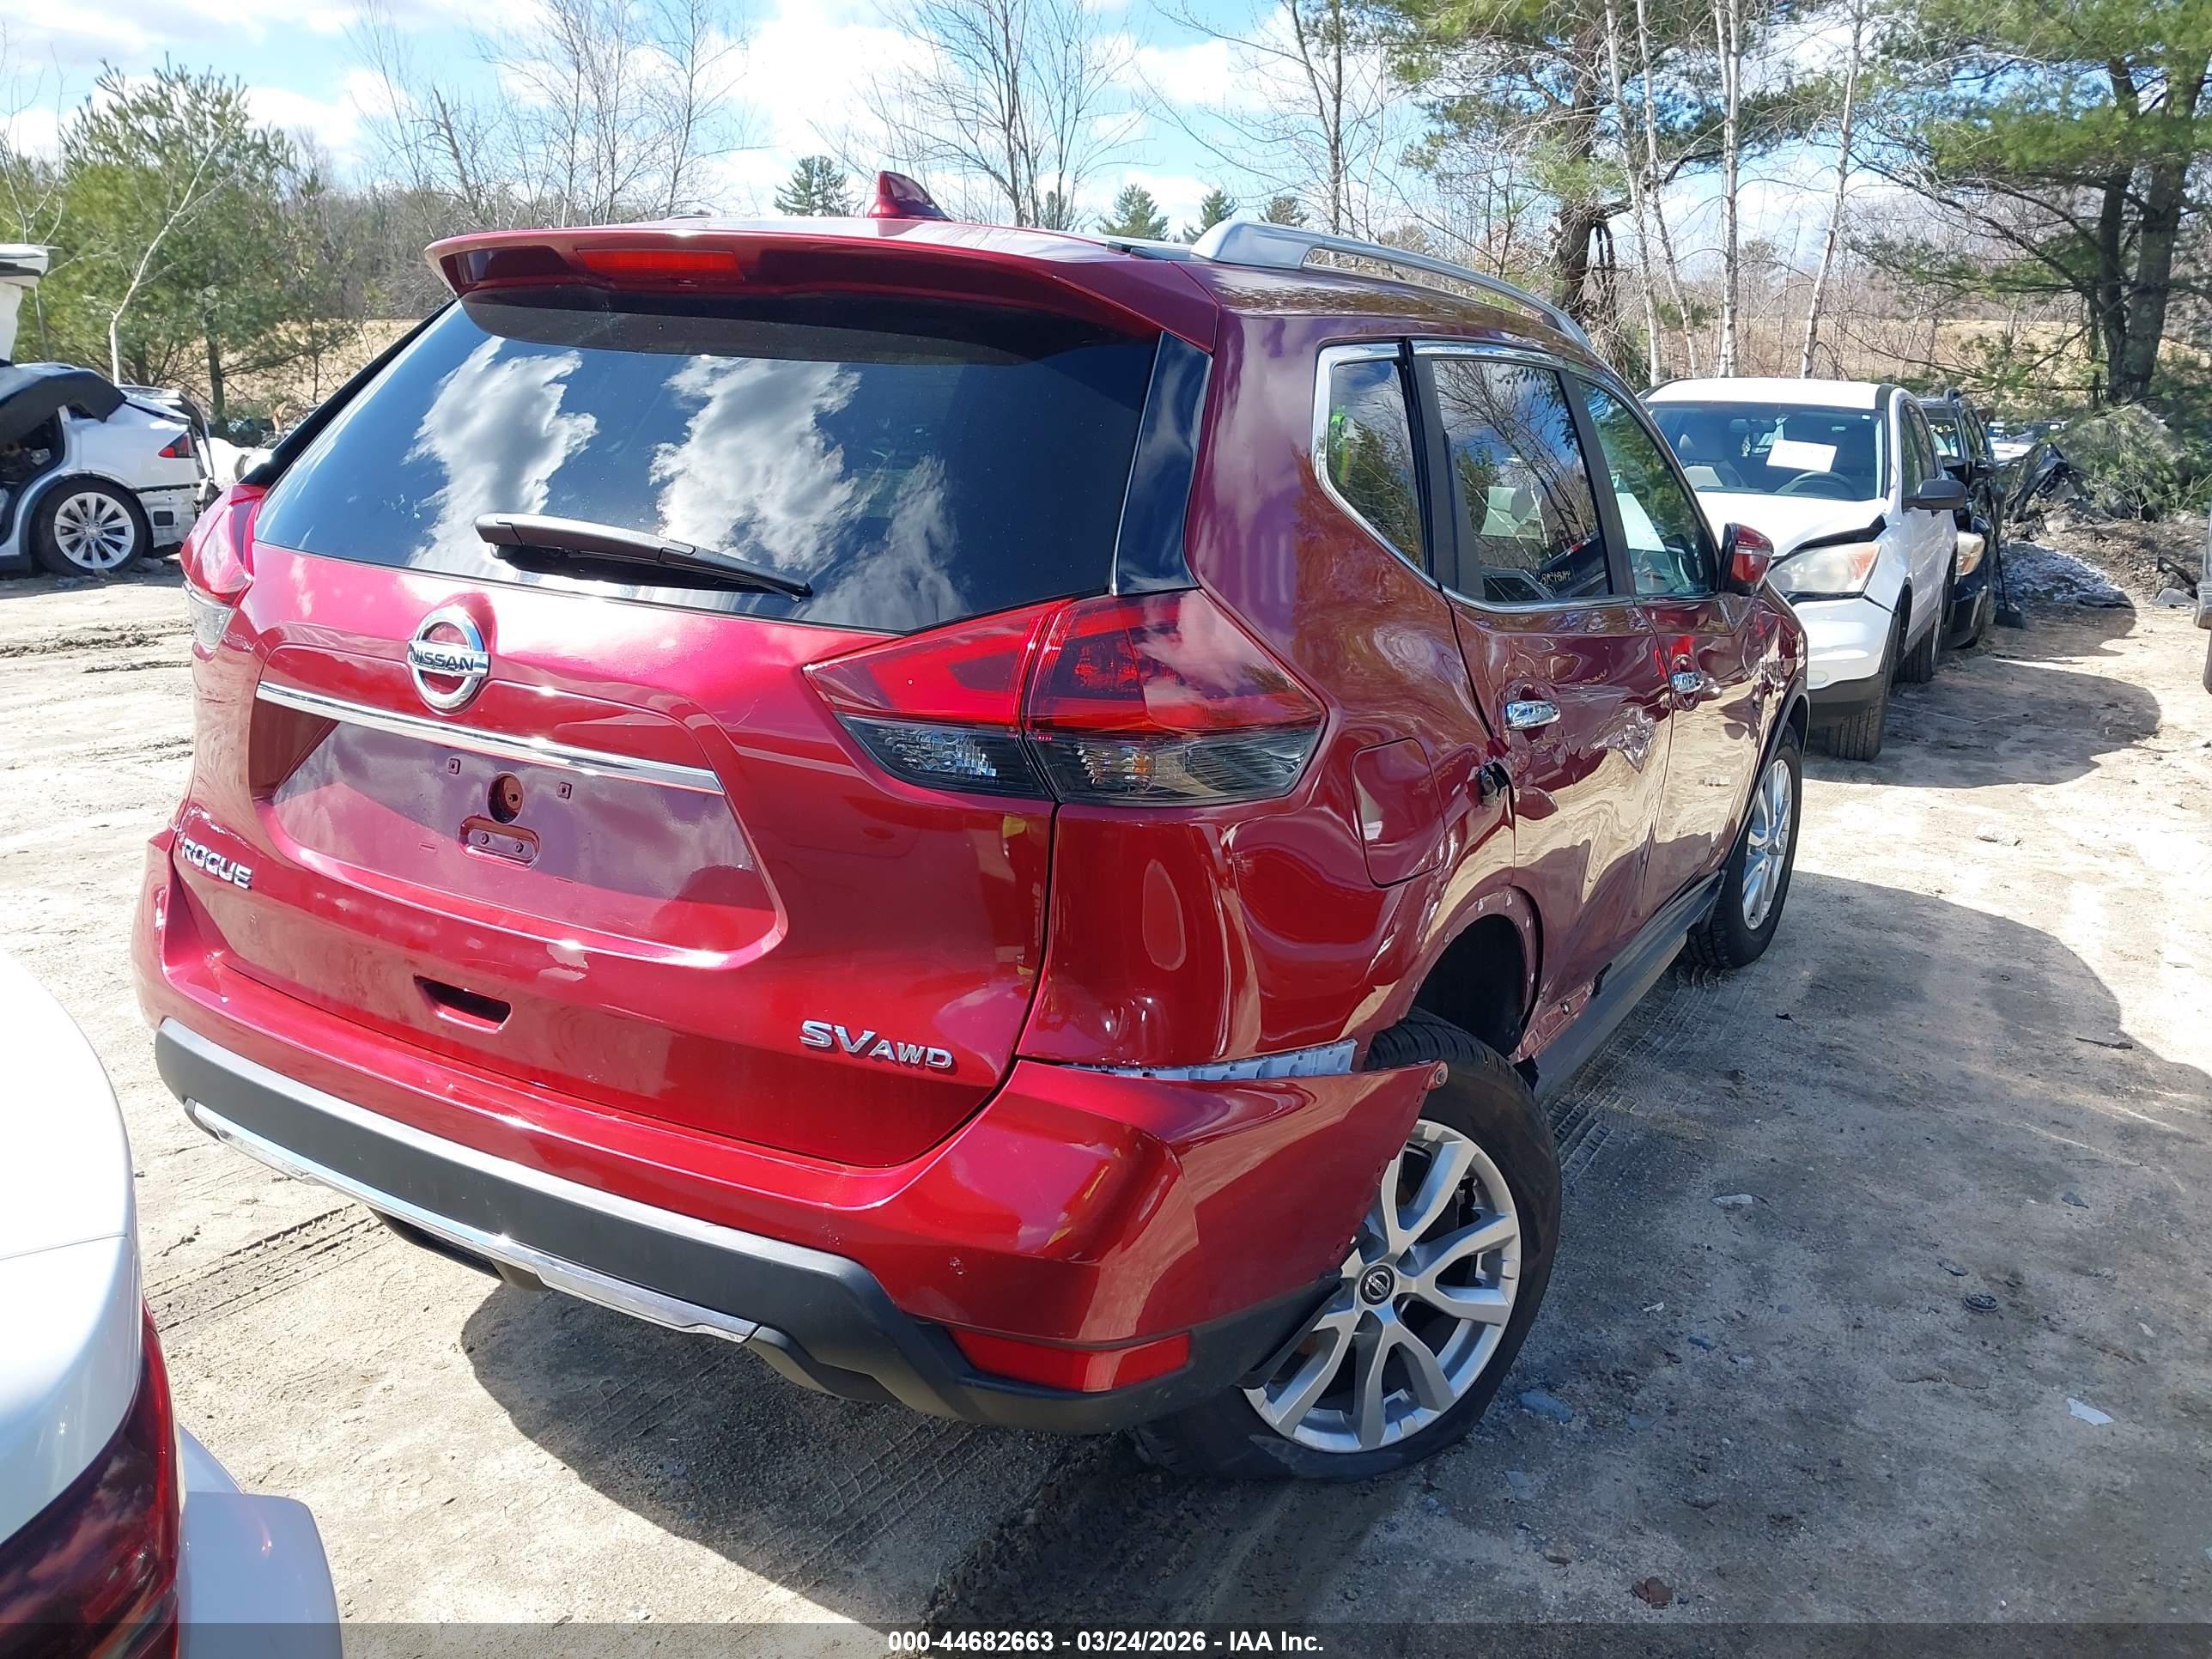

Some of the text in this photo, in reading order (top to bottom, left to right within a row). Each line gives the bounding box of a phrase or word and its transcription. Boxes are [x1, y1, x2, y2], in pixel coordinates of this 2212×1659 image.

[409, 644, 474, 672] NISSAN
[181, 838, 252, 890] ROGUE
[799, 1020, 952, 1069] SV AWD
